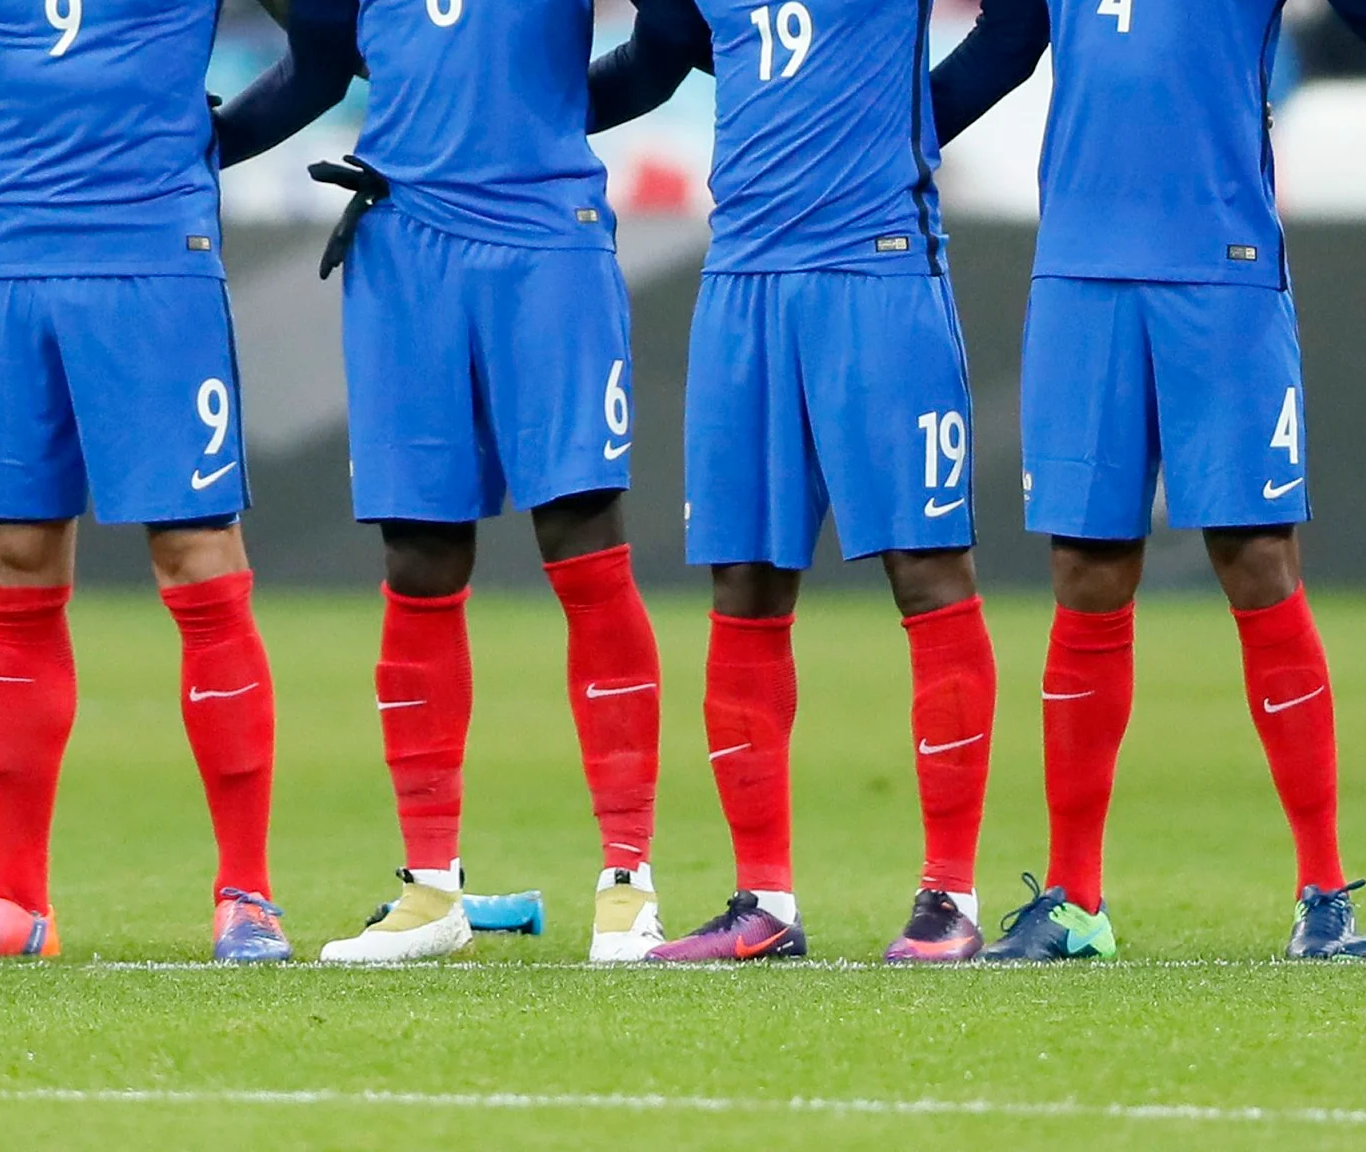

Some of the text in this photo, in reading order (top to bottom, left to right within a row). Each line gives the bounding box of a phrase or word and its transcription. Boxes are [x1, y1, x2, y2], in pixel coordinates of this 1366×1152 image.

[749, 0, 813, 81] 19
[196, 377, 230, 455] 9
[604, 359, 629, 436] 6
[1270, 386, 1299, 465] 4
[918, 410, 967, 488] 19
